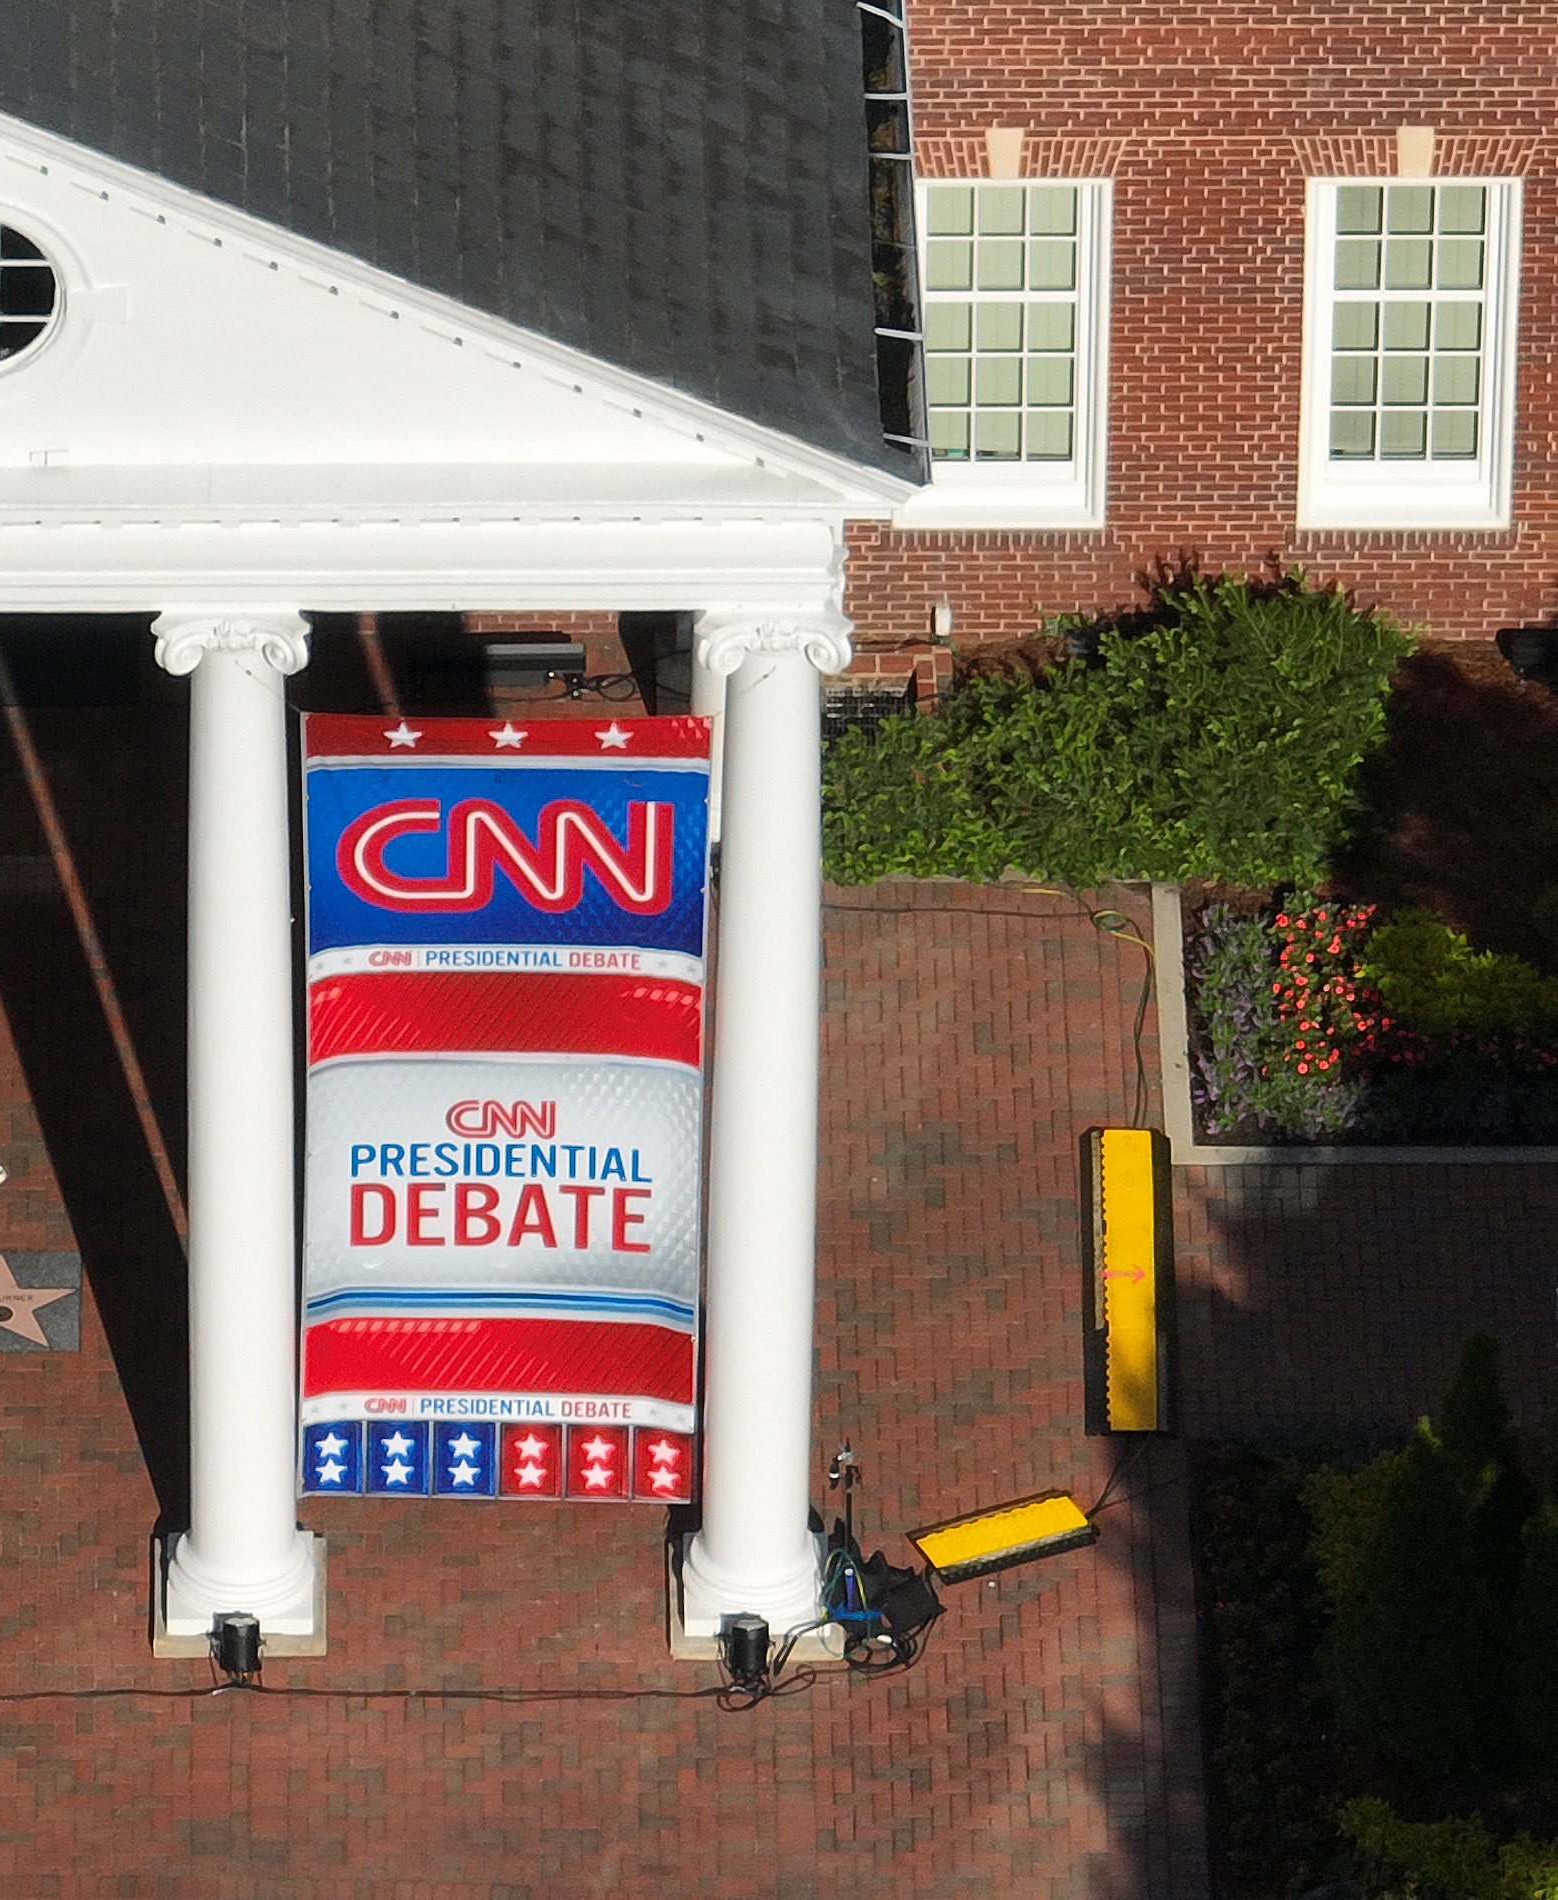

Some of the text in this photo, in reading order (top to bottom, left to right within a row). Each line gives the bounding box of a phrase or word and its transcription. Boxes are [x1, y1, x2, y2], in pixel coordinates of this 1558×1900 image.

[335, 797, 674, 915] CNN
[368, 950, 641, 970] CNN PRESIDENTIAL DEBATE
[445, 1099, 556, 1139] CNN
[350, 1143, 653, 1183] PRESIDENTIAL
[349, 1182, 652, 1253] DEBATE
[364, 1398, 632, 1419] CNN PRESIDENTIAL DEBATE
